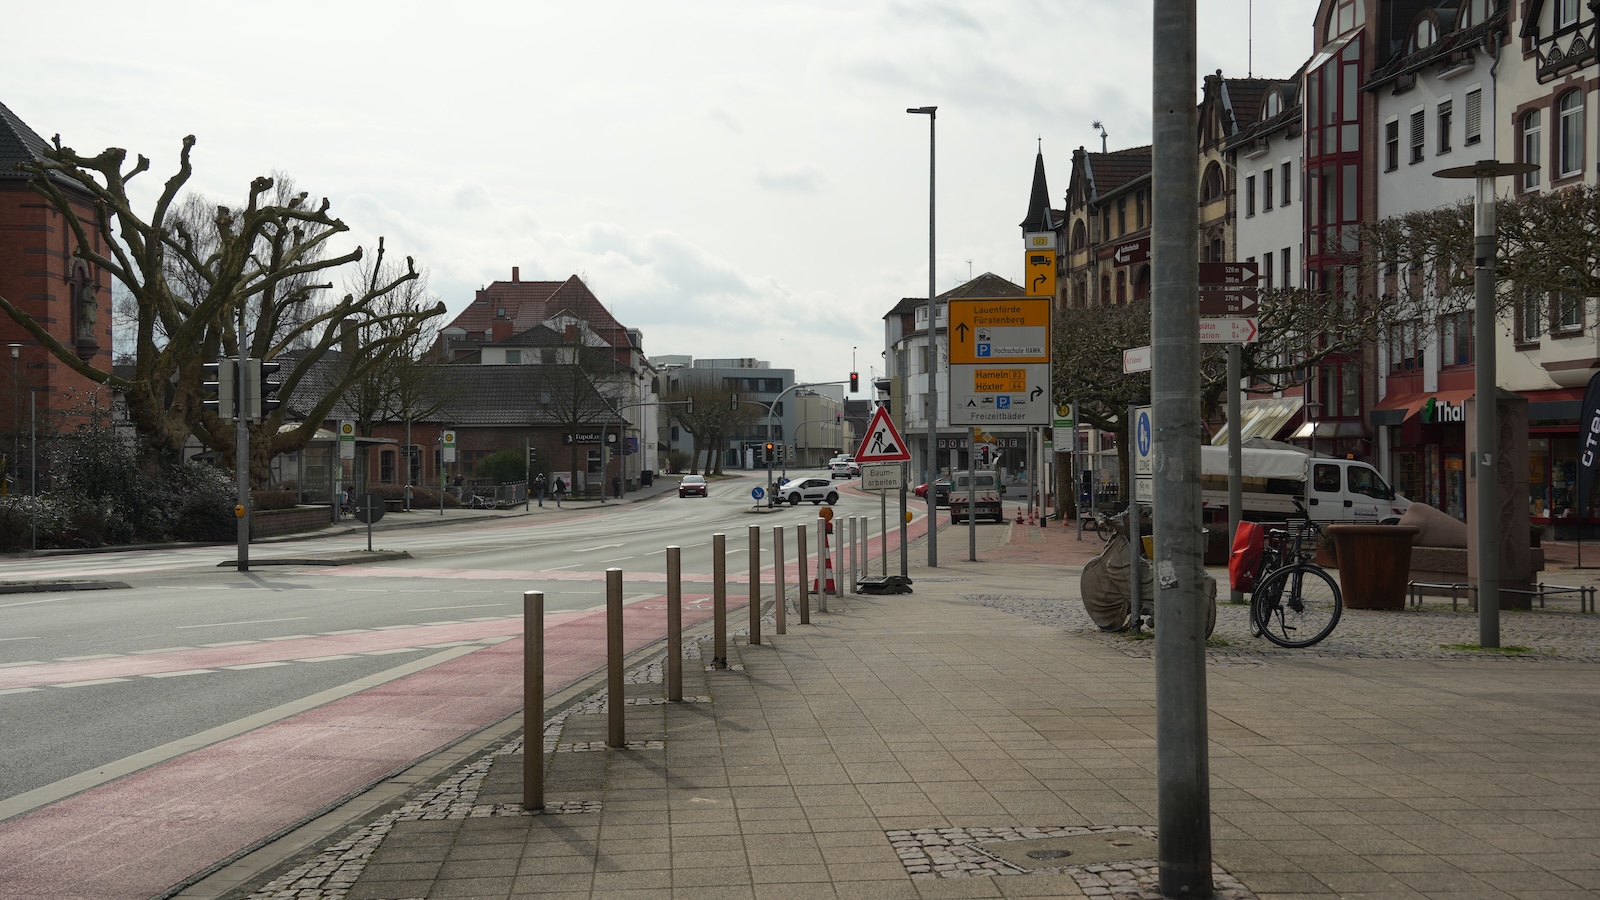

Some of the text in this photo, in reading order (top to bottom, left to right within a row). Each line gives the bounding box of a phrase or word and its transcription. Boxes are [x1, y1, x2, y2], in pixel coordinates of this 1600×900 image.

[974, 306, 1021, 314] Lauenförde
[974, 316, 1025, 325] Fürstenberg
[1199, 322, 1216, 331] plätze
[976, 382, 1004, 391] Höxter
[1435, 400, 1465, 422] Thal
[972, 412, 1026, 420] Freizeitbäder
[576, 433, 600, 441] TapaLo
[870, 469, 894, 477] Baum-
